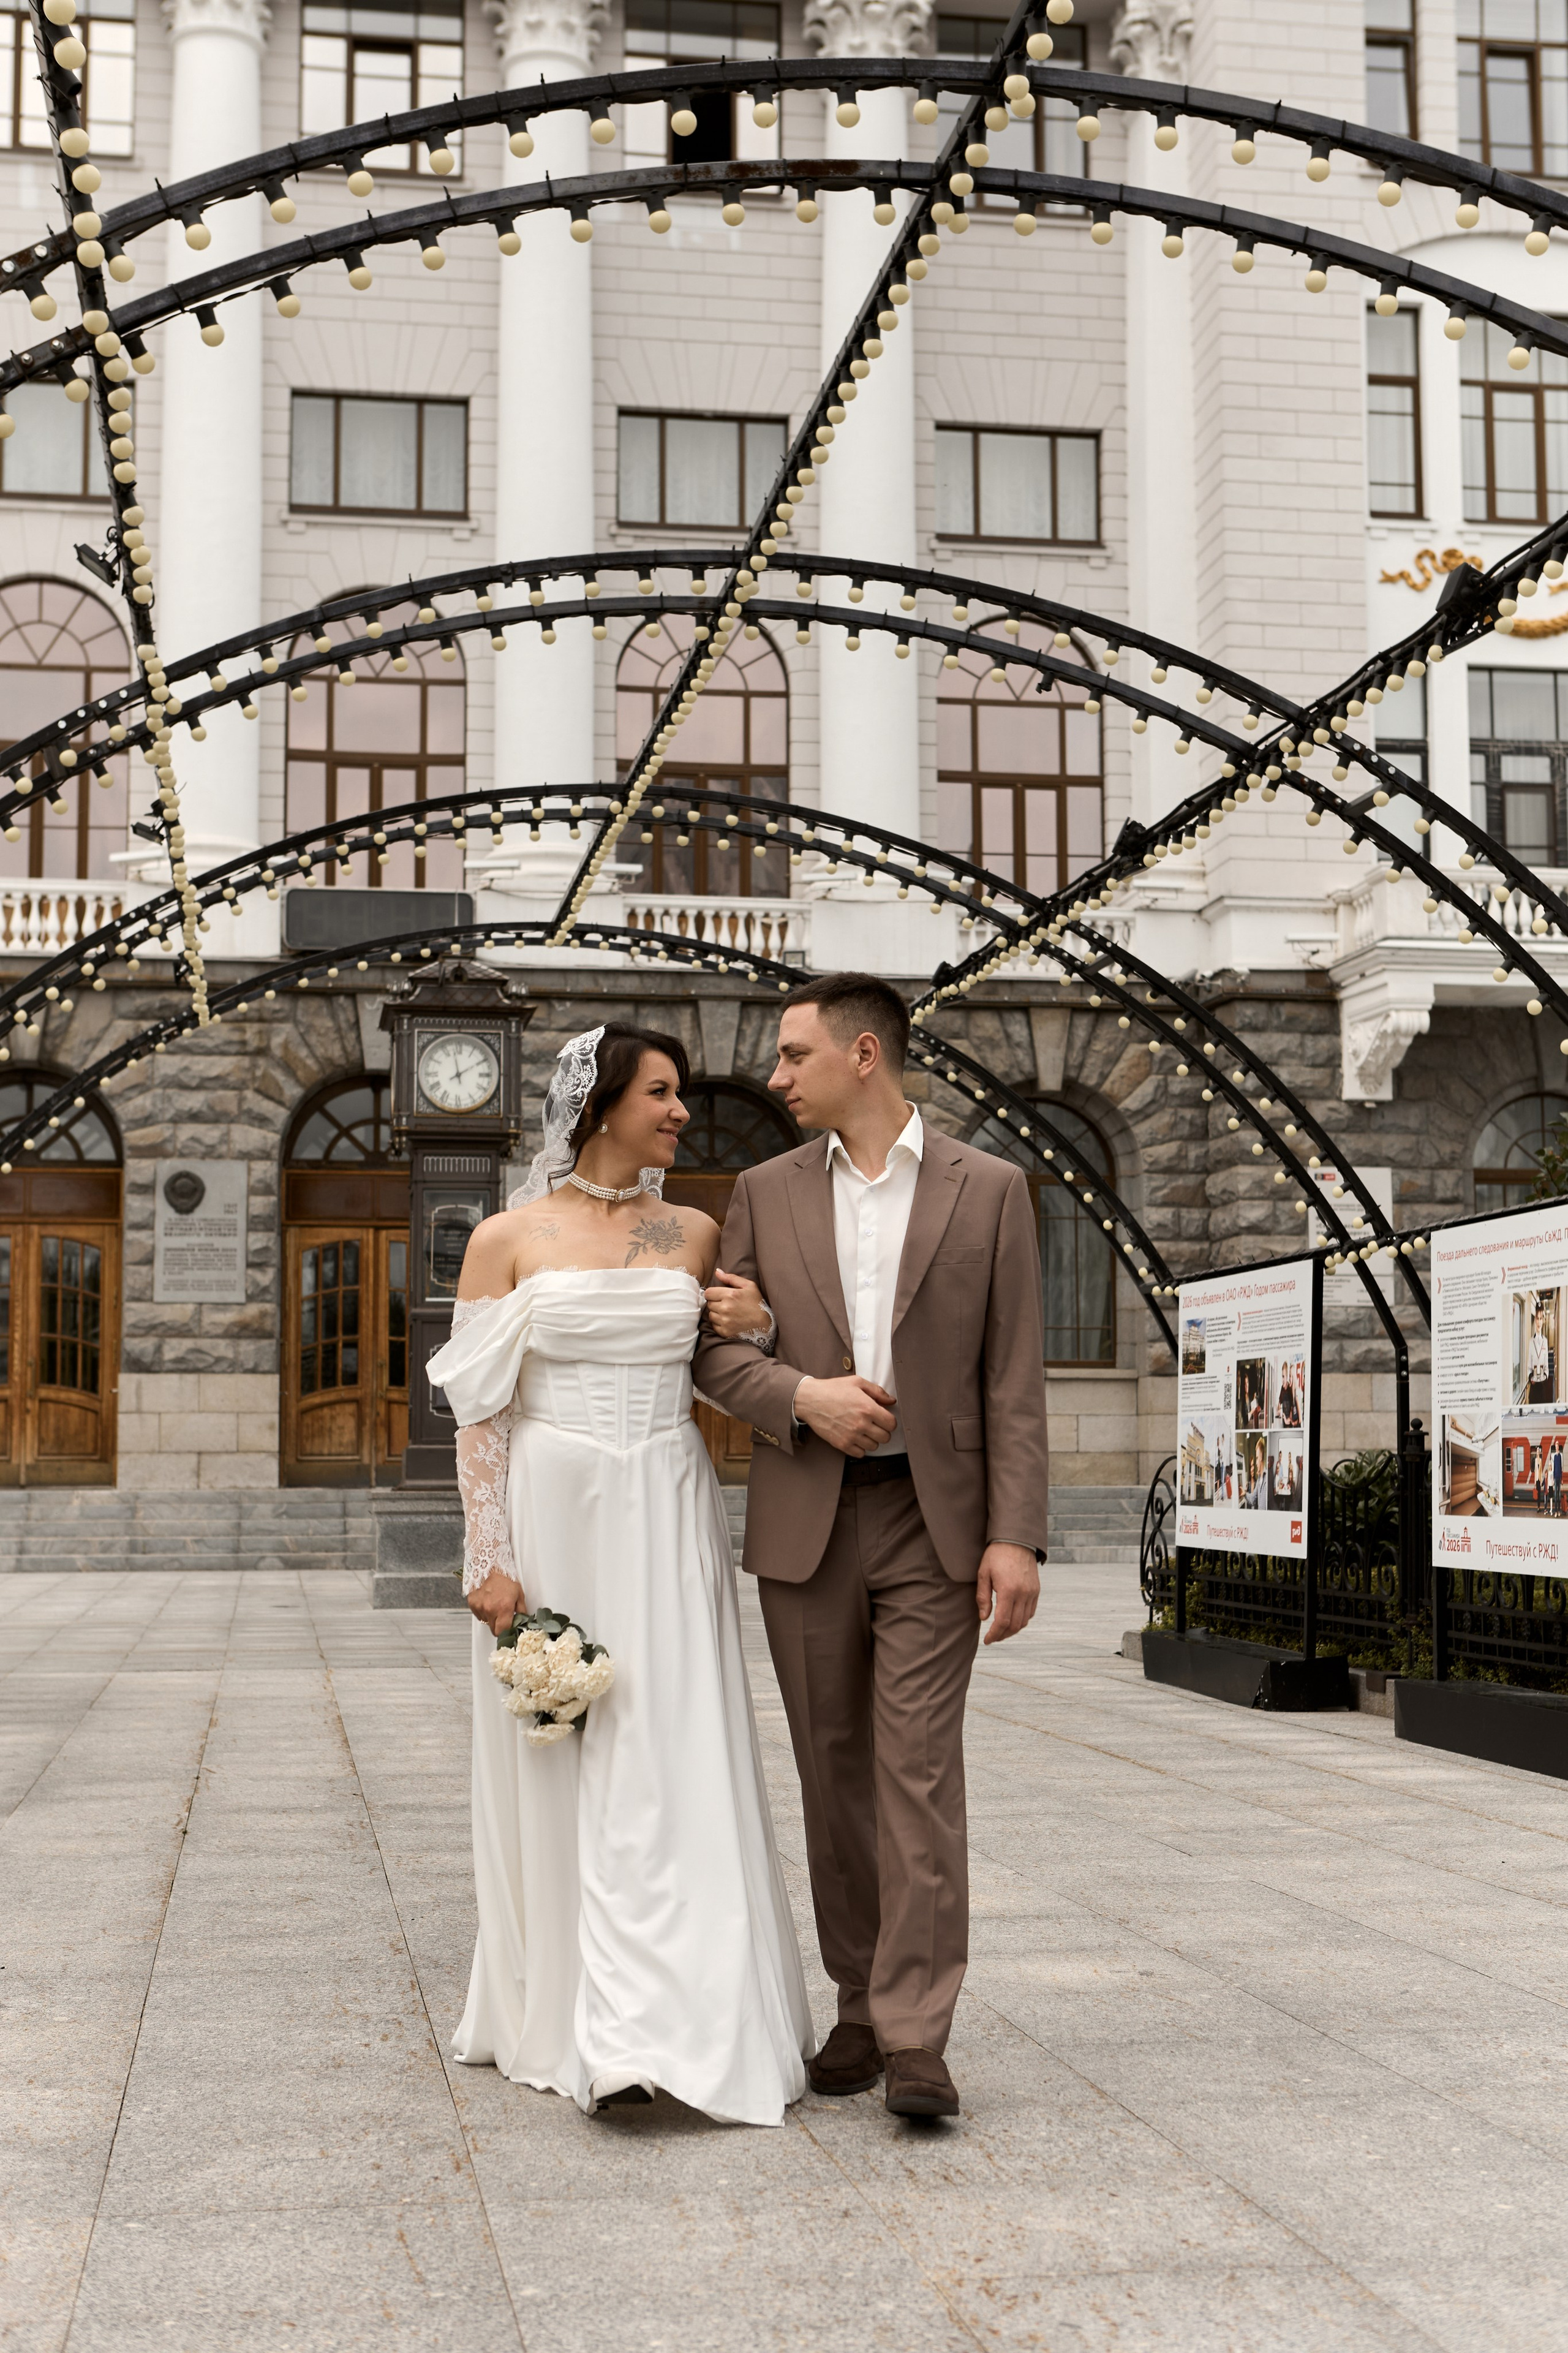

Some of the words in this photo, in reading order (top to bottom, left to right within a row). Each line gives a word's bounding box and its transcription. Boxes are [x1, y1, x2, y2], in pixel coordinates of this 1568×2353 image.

[1437, 1251, 1454, 1262] Поезда
[1455, 1247, 1478, 1260] дальнего
[1479, 1241, 1509, 1255] следования
[1510, 1241, 1513, 1249] и
[1515, 1235, 1544, 1248] маршруты
[1200, 1292, 1221, 1305] объявлен
[1226, 1288, 1237, 1301] ОАО
[1269, 1280, 1296, 1294] пассажира
[1447, 1538, 1460, 1552] 2026
[1485, 1539, 1531, 1562] Путешествуй
[1532, 1545, 1537, 1558] с
[1538, 1543, 1559, 1562] РЖД!
